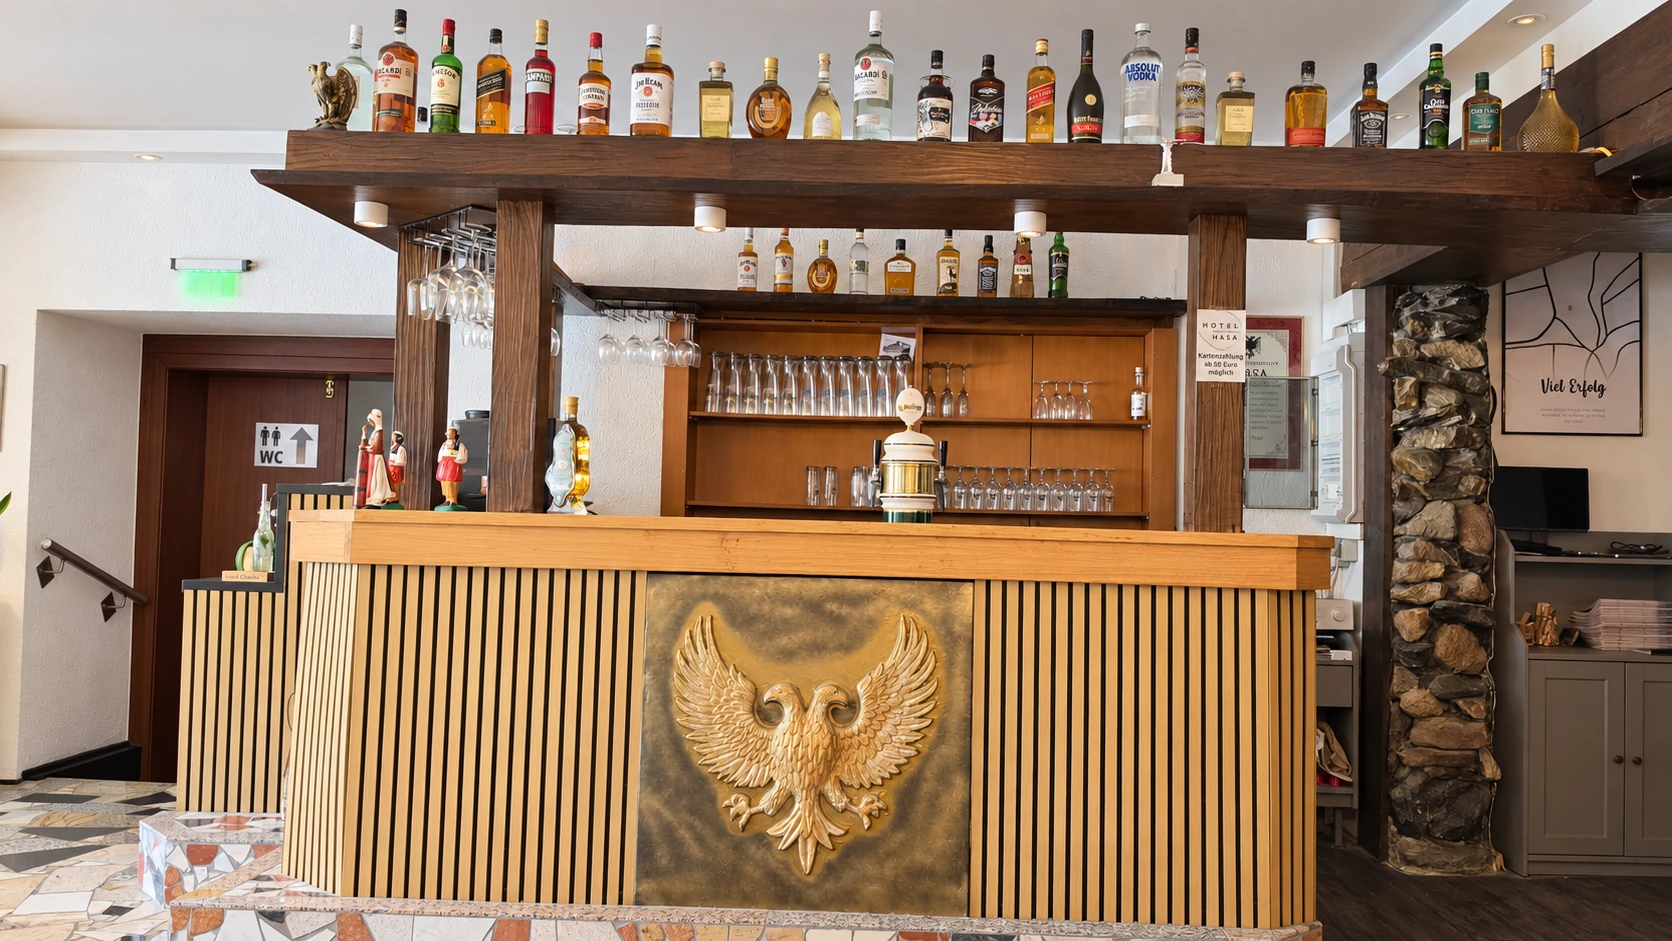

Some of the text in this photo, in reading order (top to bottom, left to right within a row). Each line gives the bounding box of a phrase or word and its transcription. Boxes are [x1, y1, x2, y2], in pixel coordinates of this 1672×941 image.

[1125, 63, 1161, 74] ABSOLUT
[1128, 71, 1157, 82] VODKA
[1198, 352, 1244, 361] Kartenzahlung
[1208, 369, 1234, 377] möglich
[1541, 377, 1607, 399] Viel Erfolg
[259, 450, 284, 464] WC
